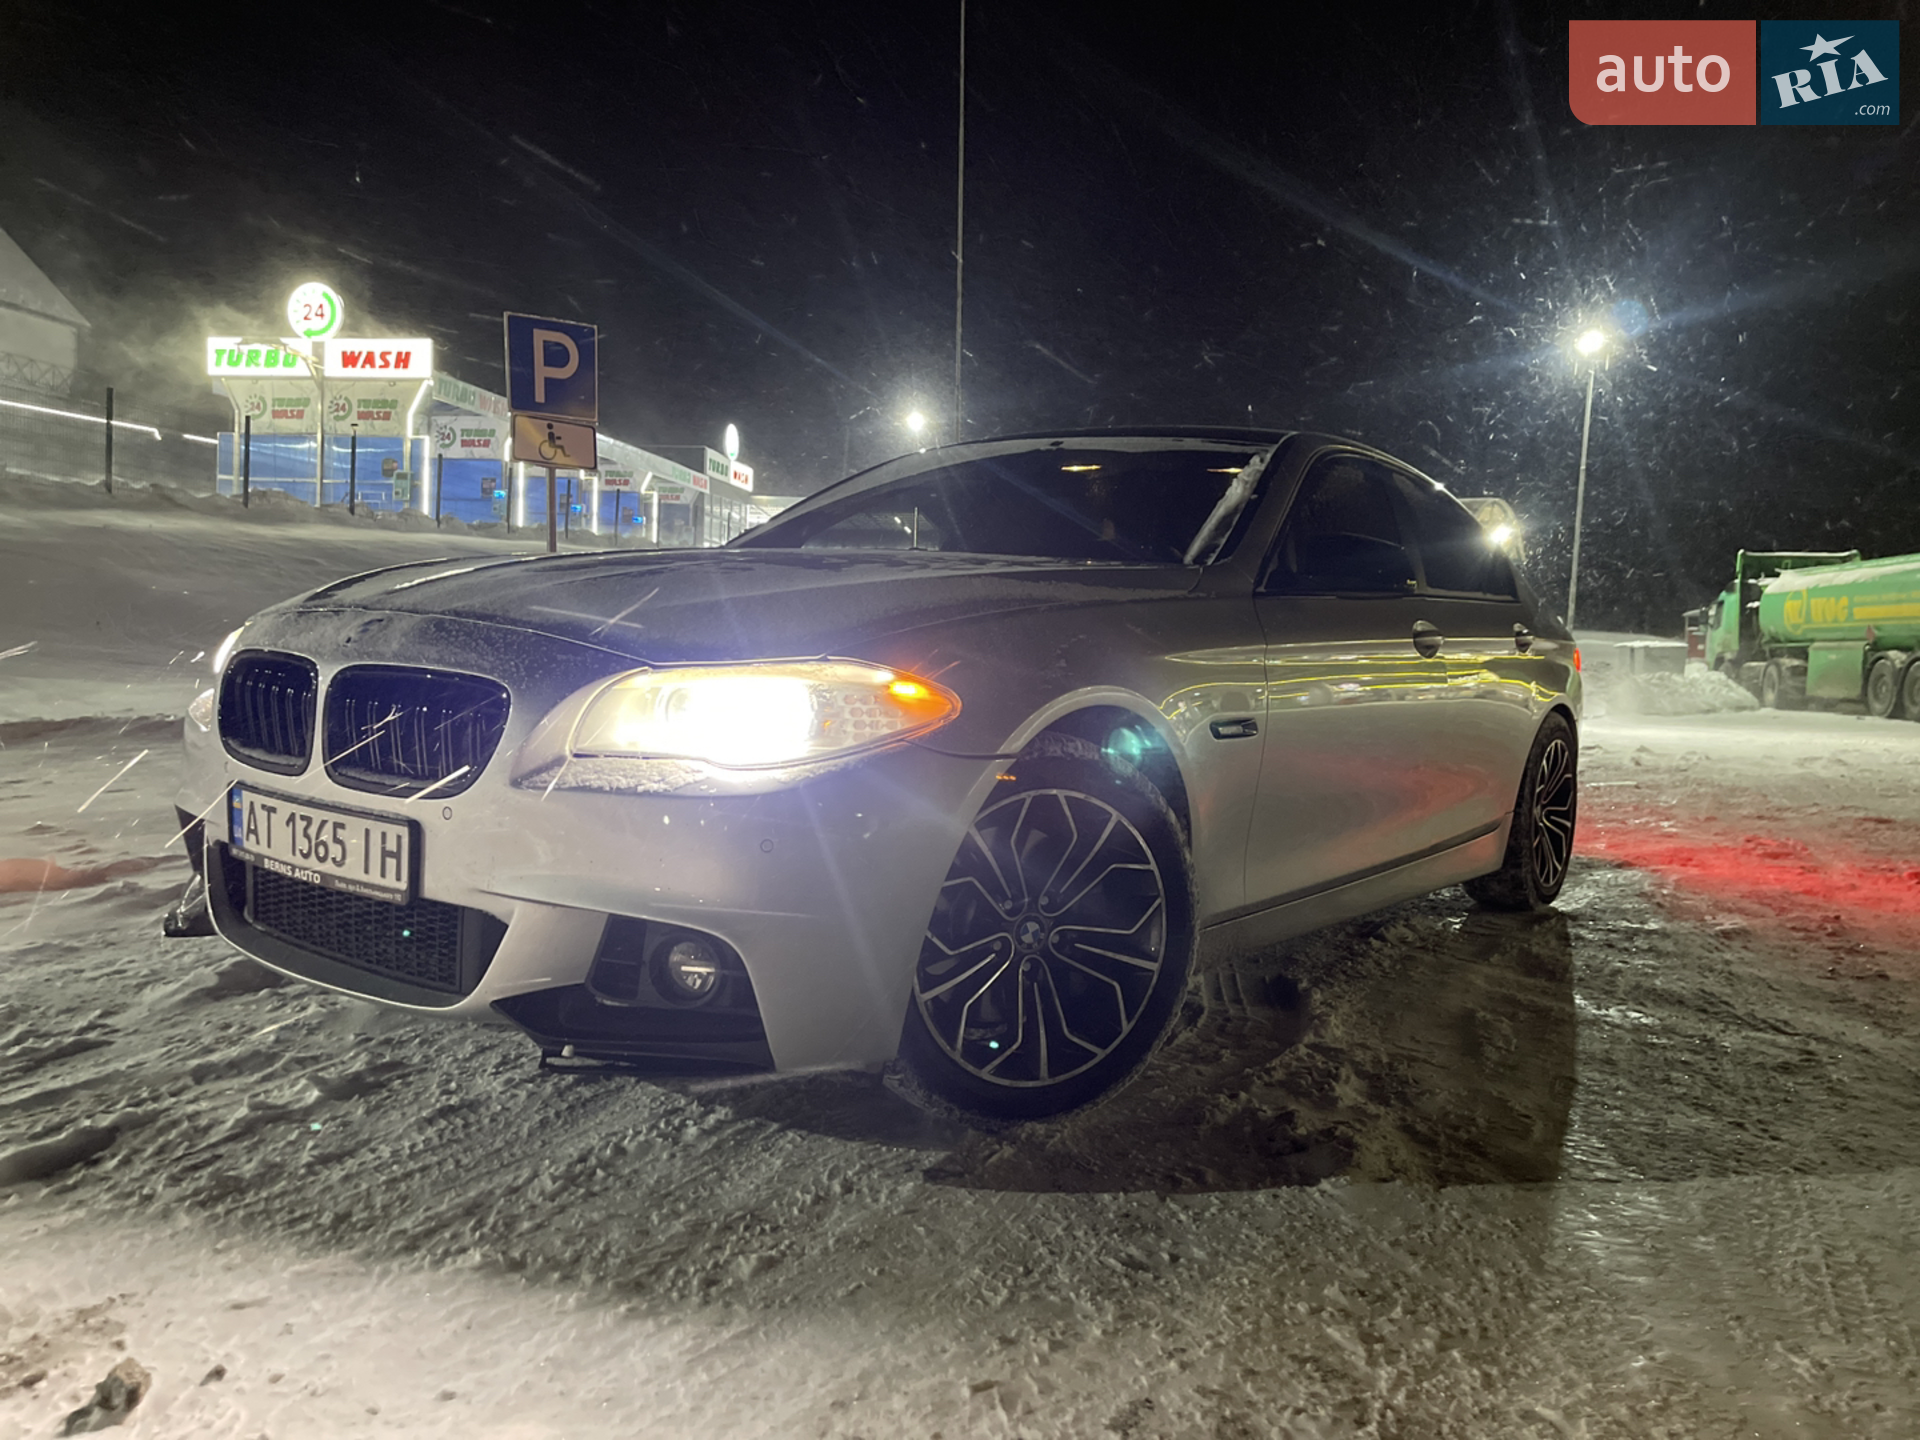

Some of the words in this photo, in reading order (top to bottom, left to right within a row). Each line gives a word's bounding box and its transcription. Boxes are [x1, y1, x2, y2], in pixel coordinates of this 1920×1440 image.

[303, 304, 326, 321] 24
[341, 351, 412, 369] WASH
[533, 328, 580, 403] P
[271, 397, 311, 408] TURBO
[334, 402, 347, 413] 24
[357, 398, 398, 409] TURBO
[271, 409, 305, 419] WASH
[357, 410, 392, 421] WASH
[440, 432, 452, 441] 24
[460, 428, 496, 438] TURBO
[460, 438, 491, 448] WASH
[245, 800, 277, 849] AT
[285, 811, 347, 868] 1365
[363, 827, 402, 882] IH
[263, 857, 293, 878] BERNS
[294, 867, 321, 885] AUTO
